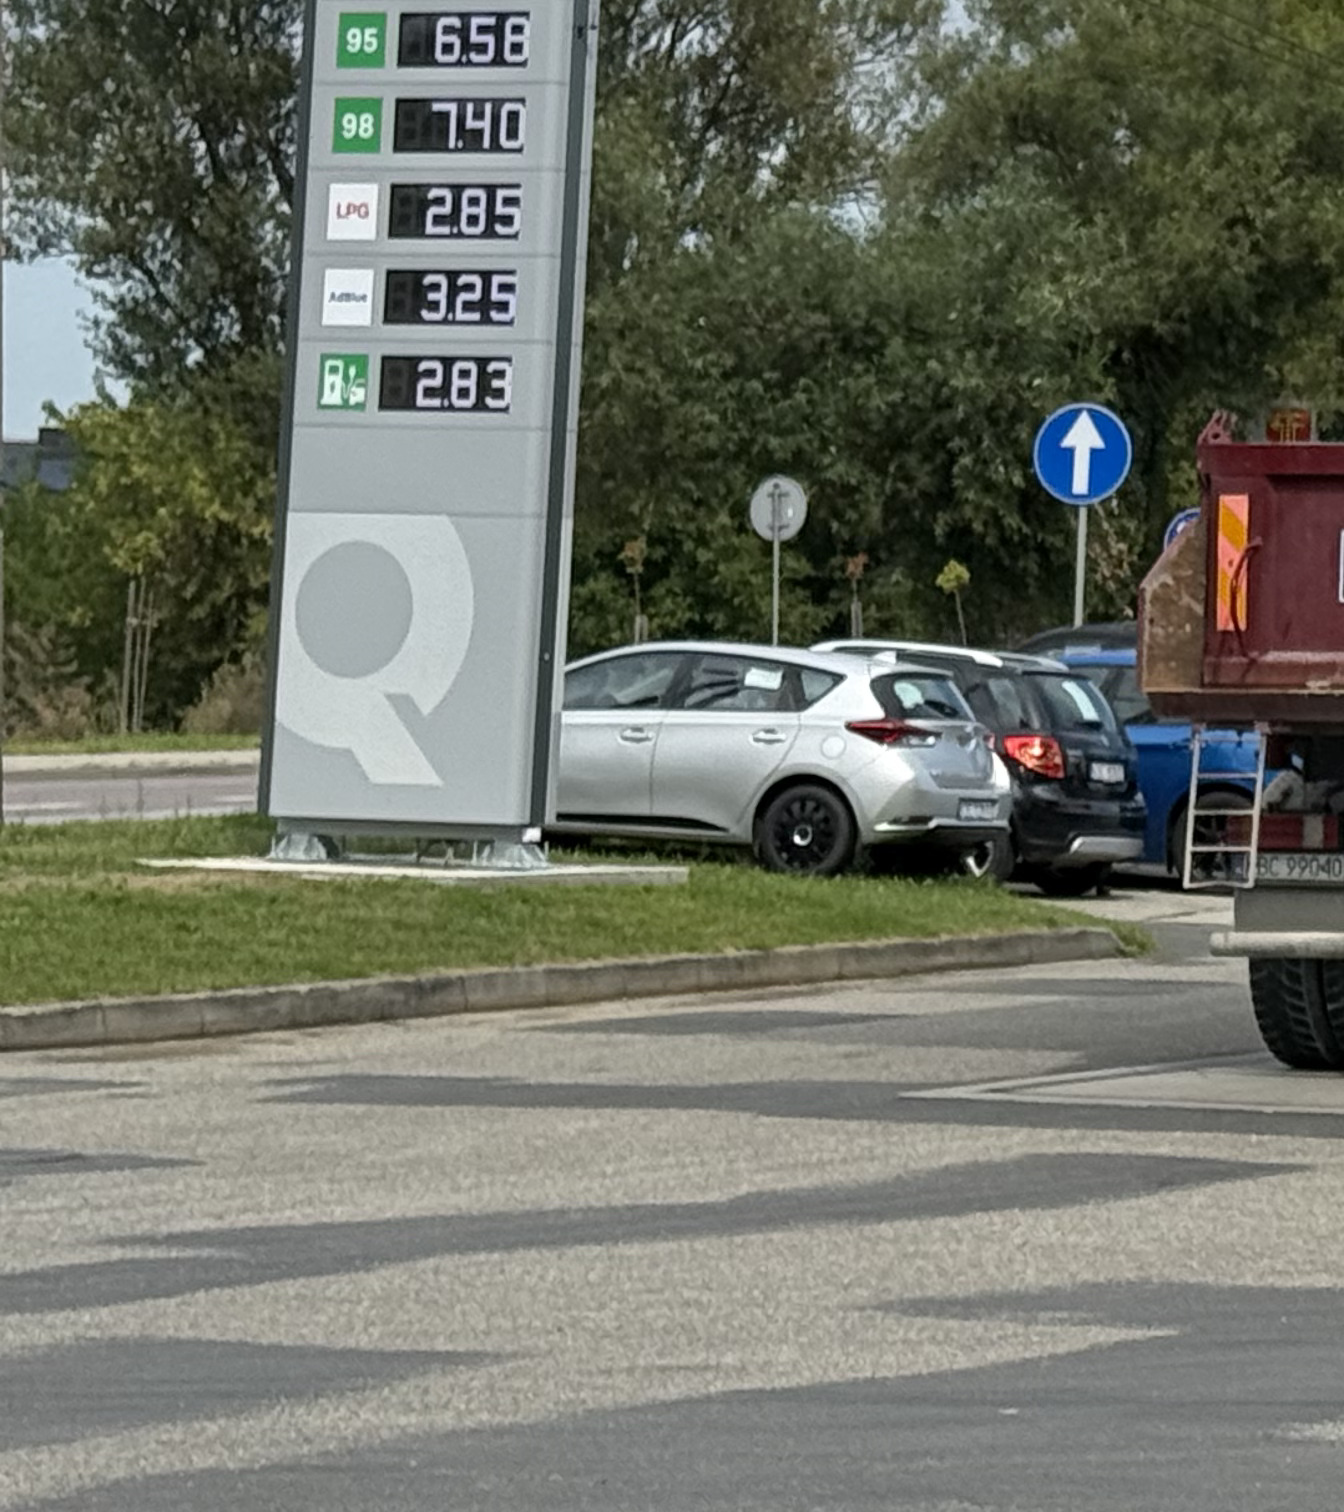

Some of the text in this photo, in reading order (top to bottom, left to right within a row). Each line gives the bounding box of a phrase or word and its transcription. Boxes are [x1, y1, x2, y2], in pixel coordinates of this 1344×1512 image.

[346, 16, 529, 64] 95 6.58
[342, 102, 525, 150] 98 7.40
[336, 188, 521, 235] LPG 2.85
[328, 274, 516, 322] AdBlue 3.25
[415, 360, 511, 409] 2.83
[1286, 856, 1343, 878] 99040
